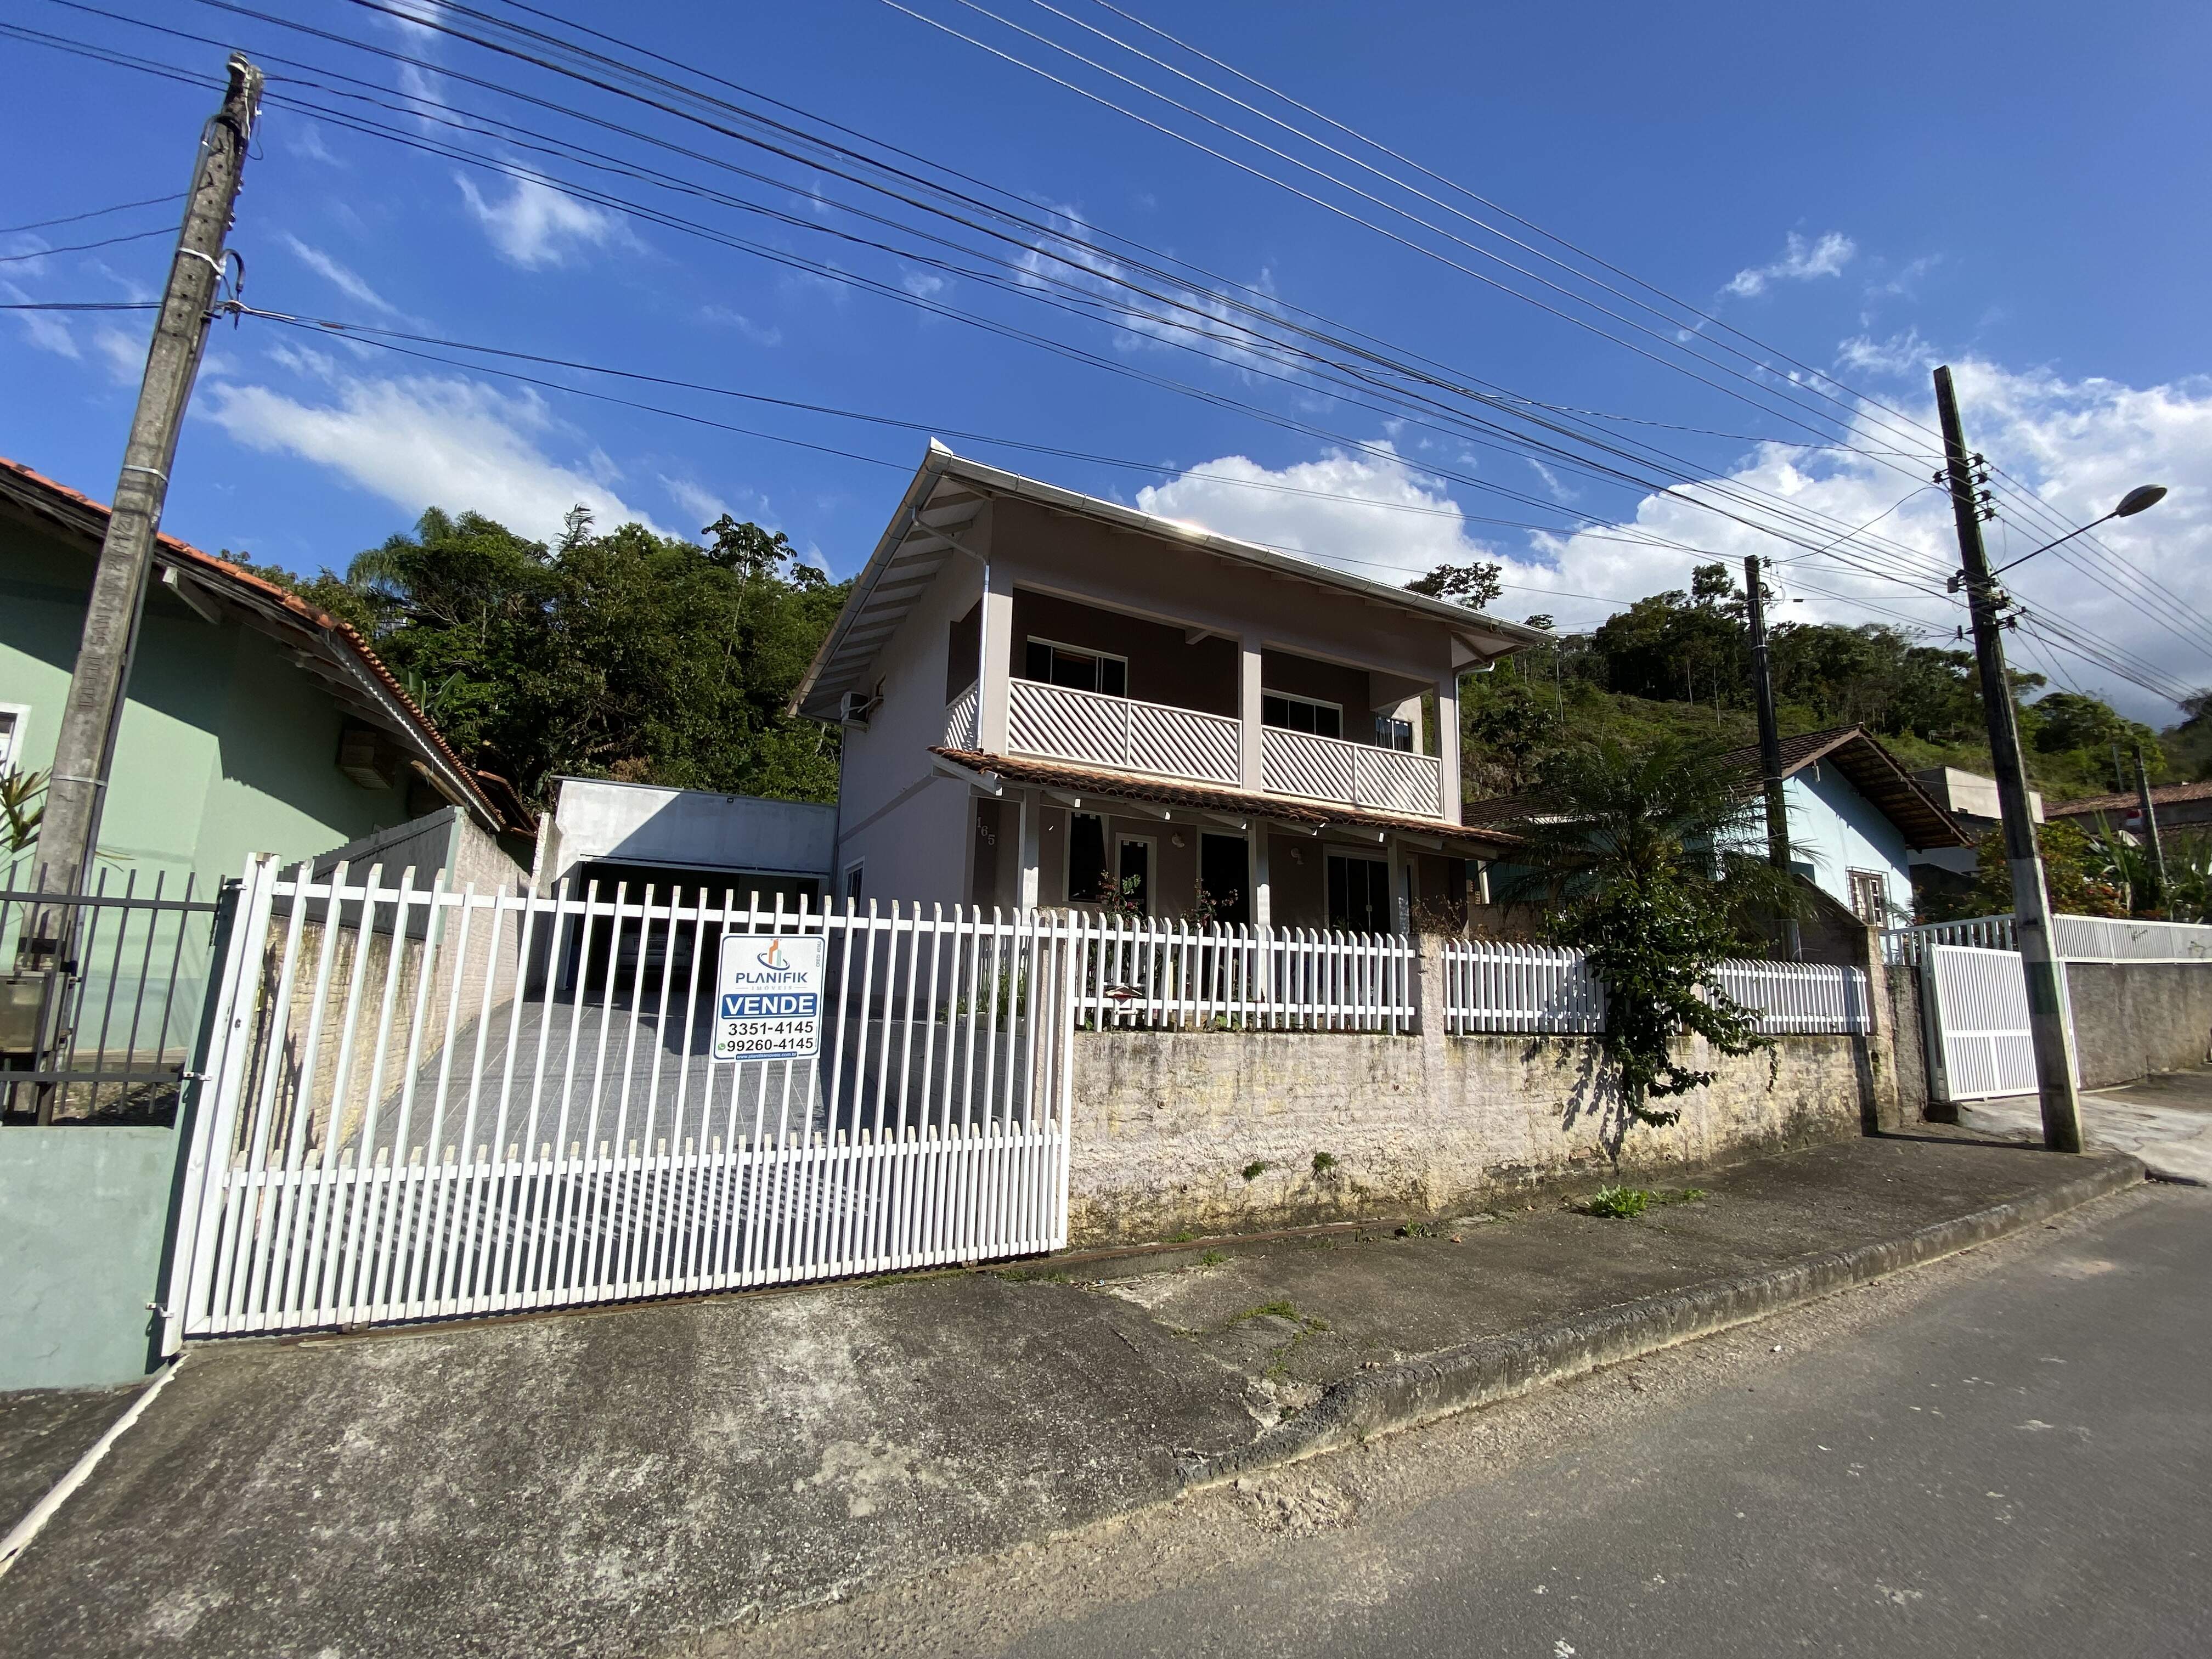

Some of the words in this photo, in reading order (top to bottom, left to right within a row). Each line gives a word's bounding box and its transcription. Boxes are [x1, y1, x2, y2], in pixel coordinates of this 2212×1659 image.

[977, 817, 995, 845] 165
[736, 972, 808, 984] PLANIFIK
[725, 995, 814, 1015] VENDE
[728, 1021, 814, 1036] 3351-4145
[727, 1038, 813, 1052] 99260-4145
